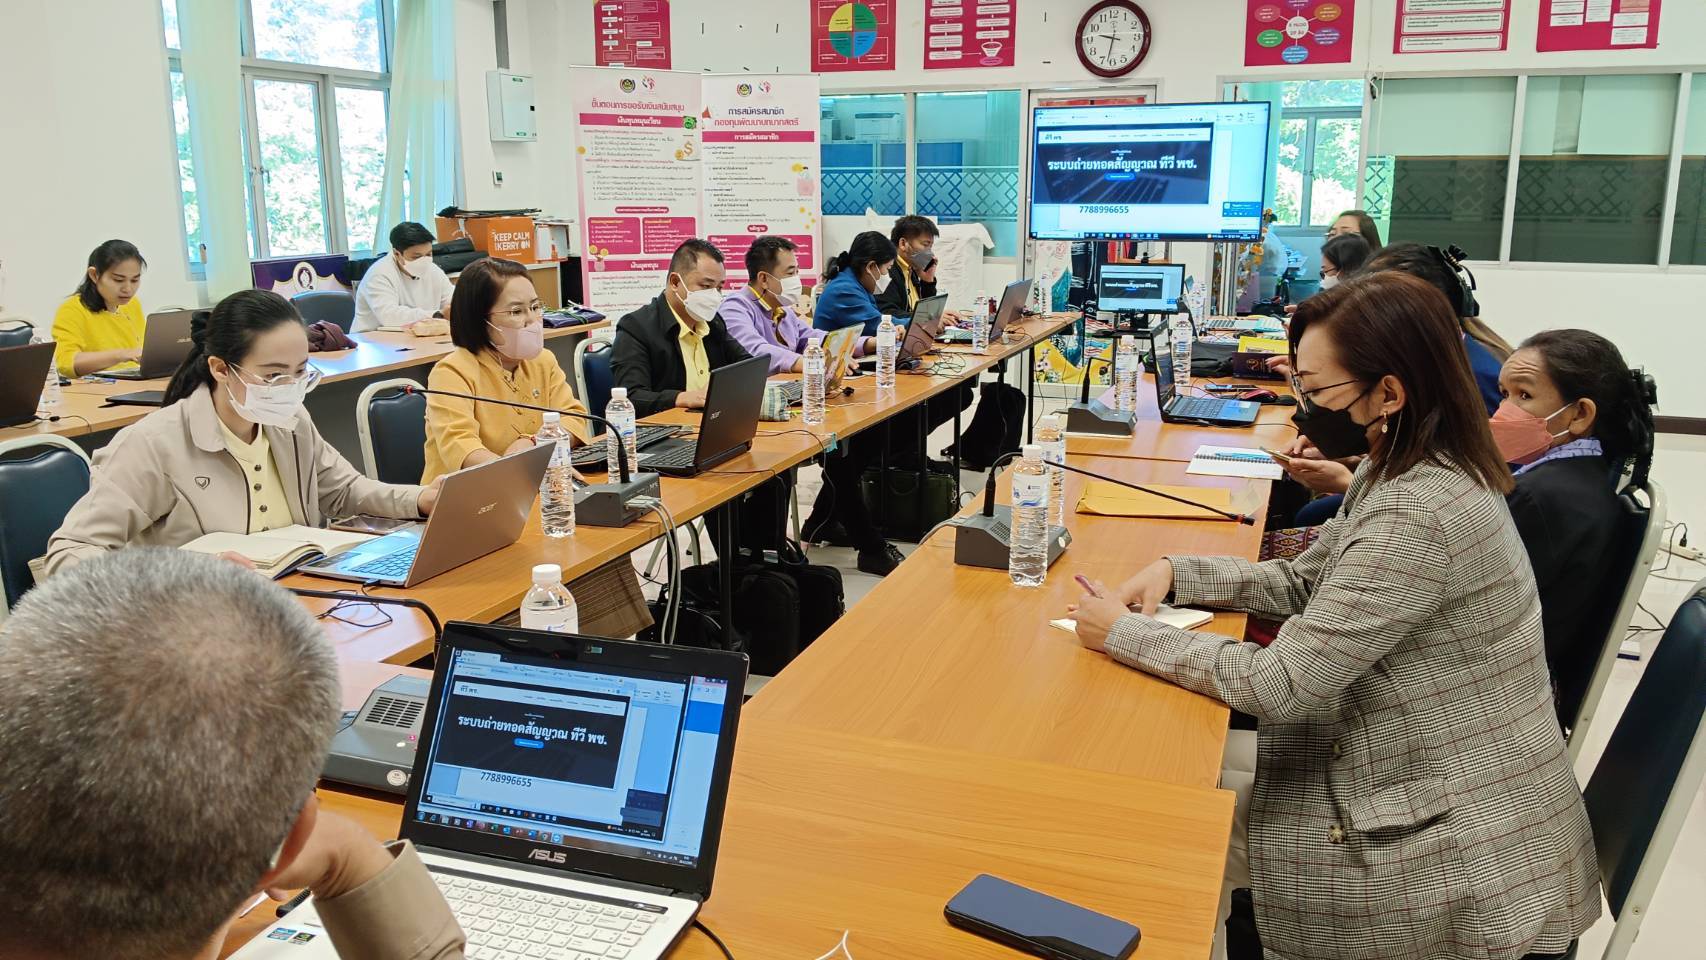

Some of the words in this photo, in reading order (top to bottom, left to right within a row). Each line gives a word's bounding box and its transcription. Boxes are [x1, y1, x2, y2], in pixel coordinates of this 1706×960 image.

[1099, 14, 1107, 23] 11
[1109, 10, 1119, 19] 12
[1123, 12, 1127, 21] 1
[1091, 23, 1100, 32] 10
[1130, 20, 1138, 30] 2
[1086, 36, 1094, 44] 9
[1133, 33, 1141, 41] 3
[1089, 47, 1097, 56] 8
[1130, 45, 1136, 53] 4
[1099, 56, 1106, 65] 7
[1109, 58, 1117, 67] 6
[1120, 55, 1128, 63] 5
[591, 98, 685, 113] ขั้นตอนการขอรับเงินสนับสนุน
[728, 106, 785, 115] การสมัครสมาชิก
[617, 115, 662, 126] เงินทุนหมุนเวียน
[714, 117, 799, 128] กองทุนพัฒนาบทบาทสตรี
[734, 132, 779, 141] การสมัครสมาชิก
[1047, 156, 1157, 172] ระบบถ่ายทอดสัญญาณ
[1159, 155, 1175, 169] ทีวี
[1176, 158, 1197, 169] พช.
[1079, 205, 1129, 214] 7788996655
[495, 232, 512, 242] KEEP
[513, 232, 530, 241] CALM
[497, 241, 520, 251] KERRY
[521, 240, 530, 249] ON
[458, 715, 568, 740] ระบบถ่ายทอดสัญญาณ
[570, 727, 588, 742] ทีวี
[588, 732, 608, 745] พช.
[480, 771, 532, 788] 7788996655
[528, 849, 567, 863] ASUS
